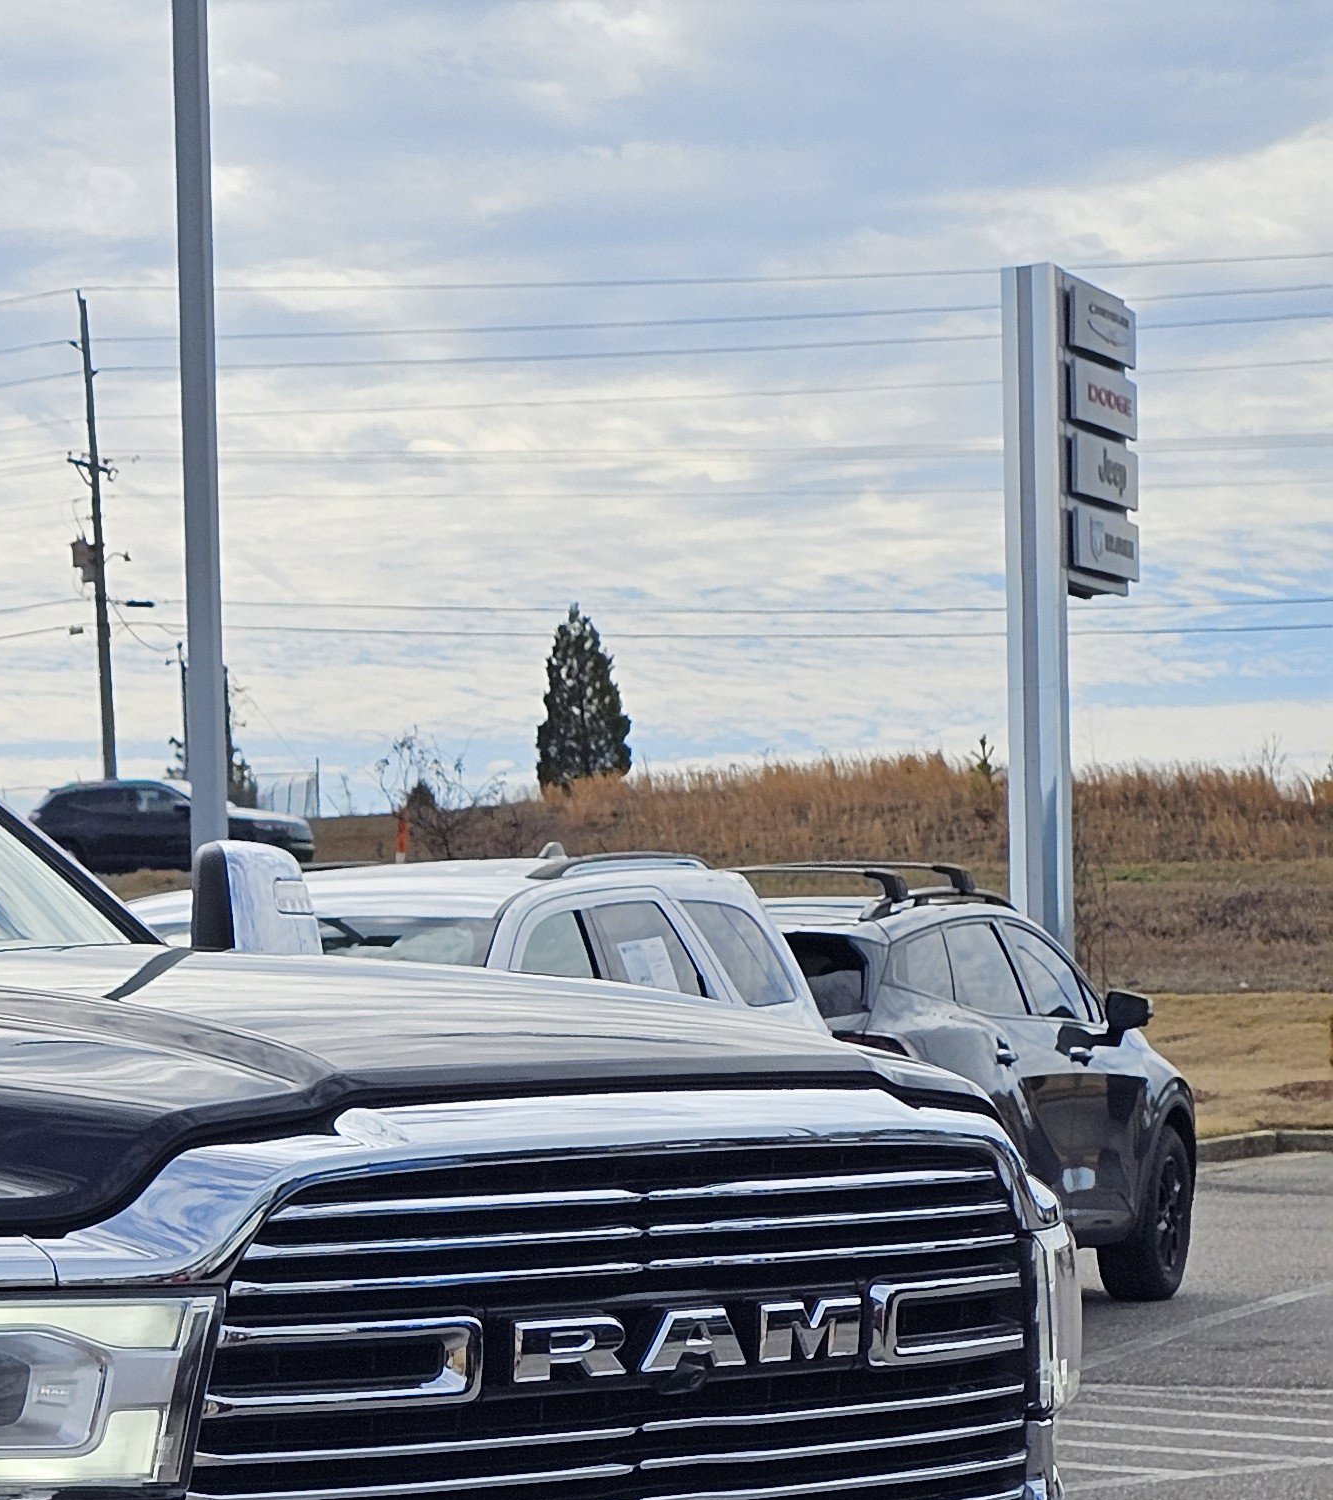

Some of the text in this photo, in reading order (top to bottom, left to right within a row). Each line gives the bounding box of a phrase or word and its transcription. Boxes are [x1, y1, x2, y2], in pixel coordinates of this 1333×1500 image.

[1088, 382, 1132, 418] DODGE
[1097, 446, 1127, 498] Jeep
[513, 1297, 862, 1383] RAM
